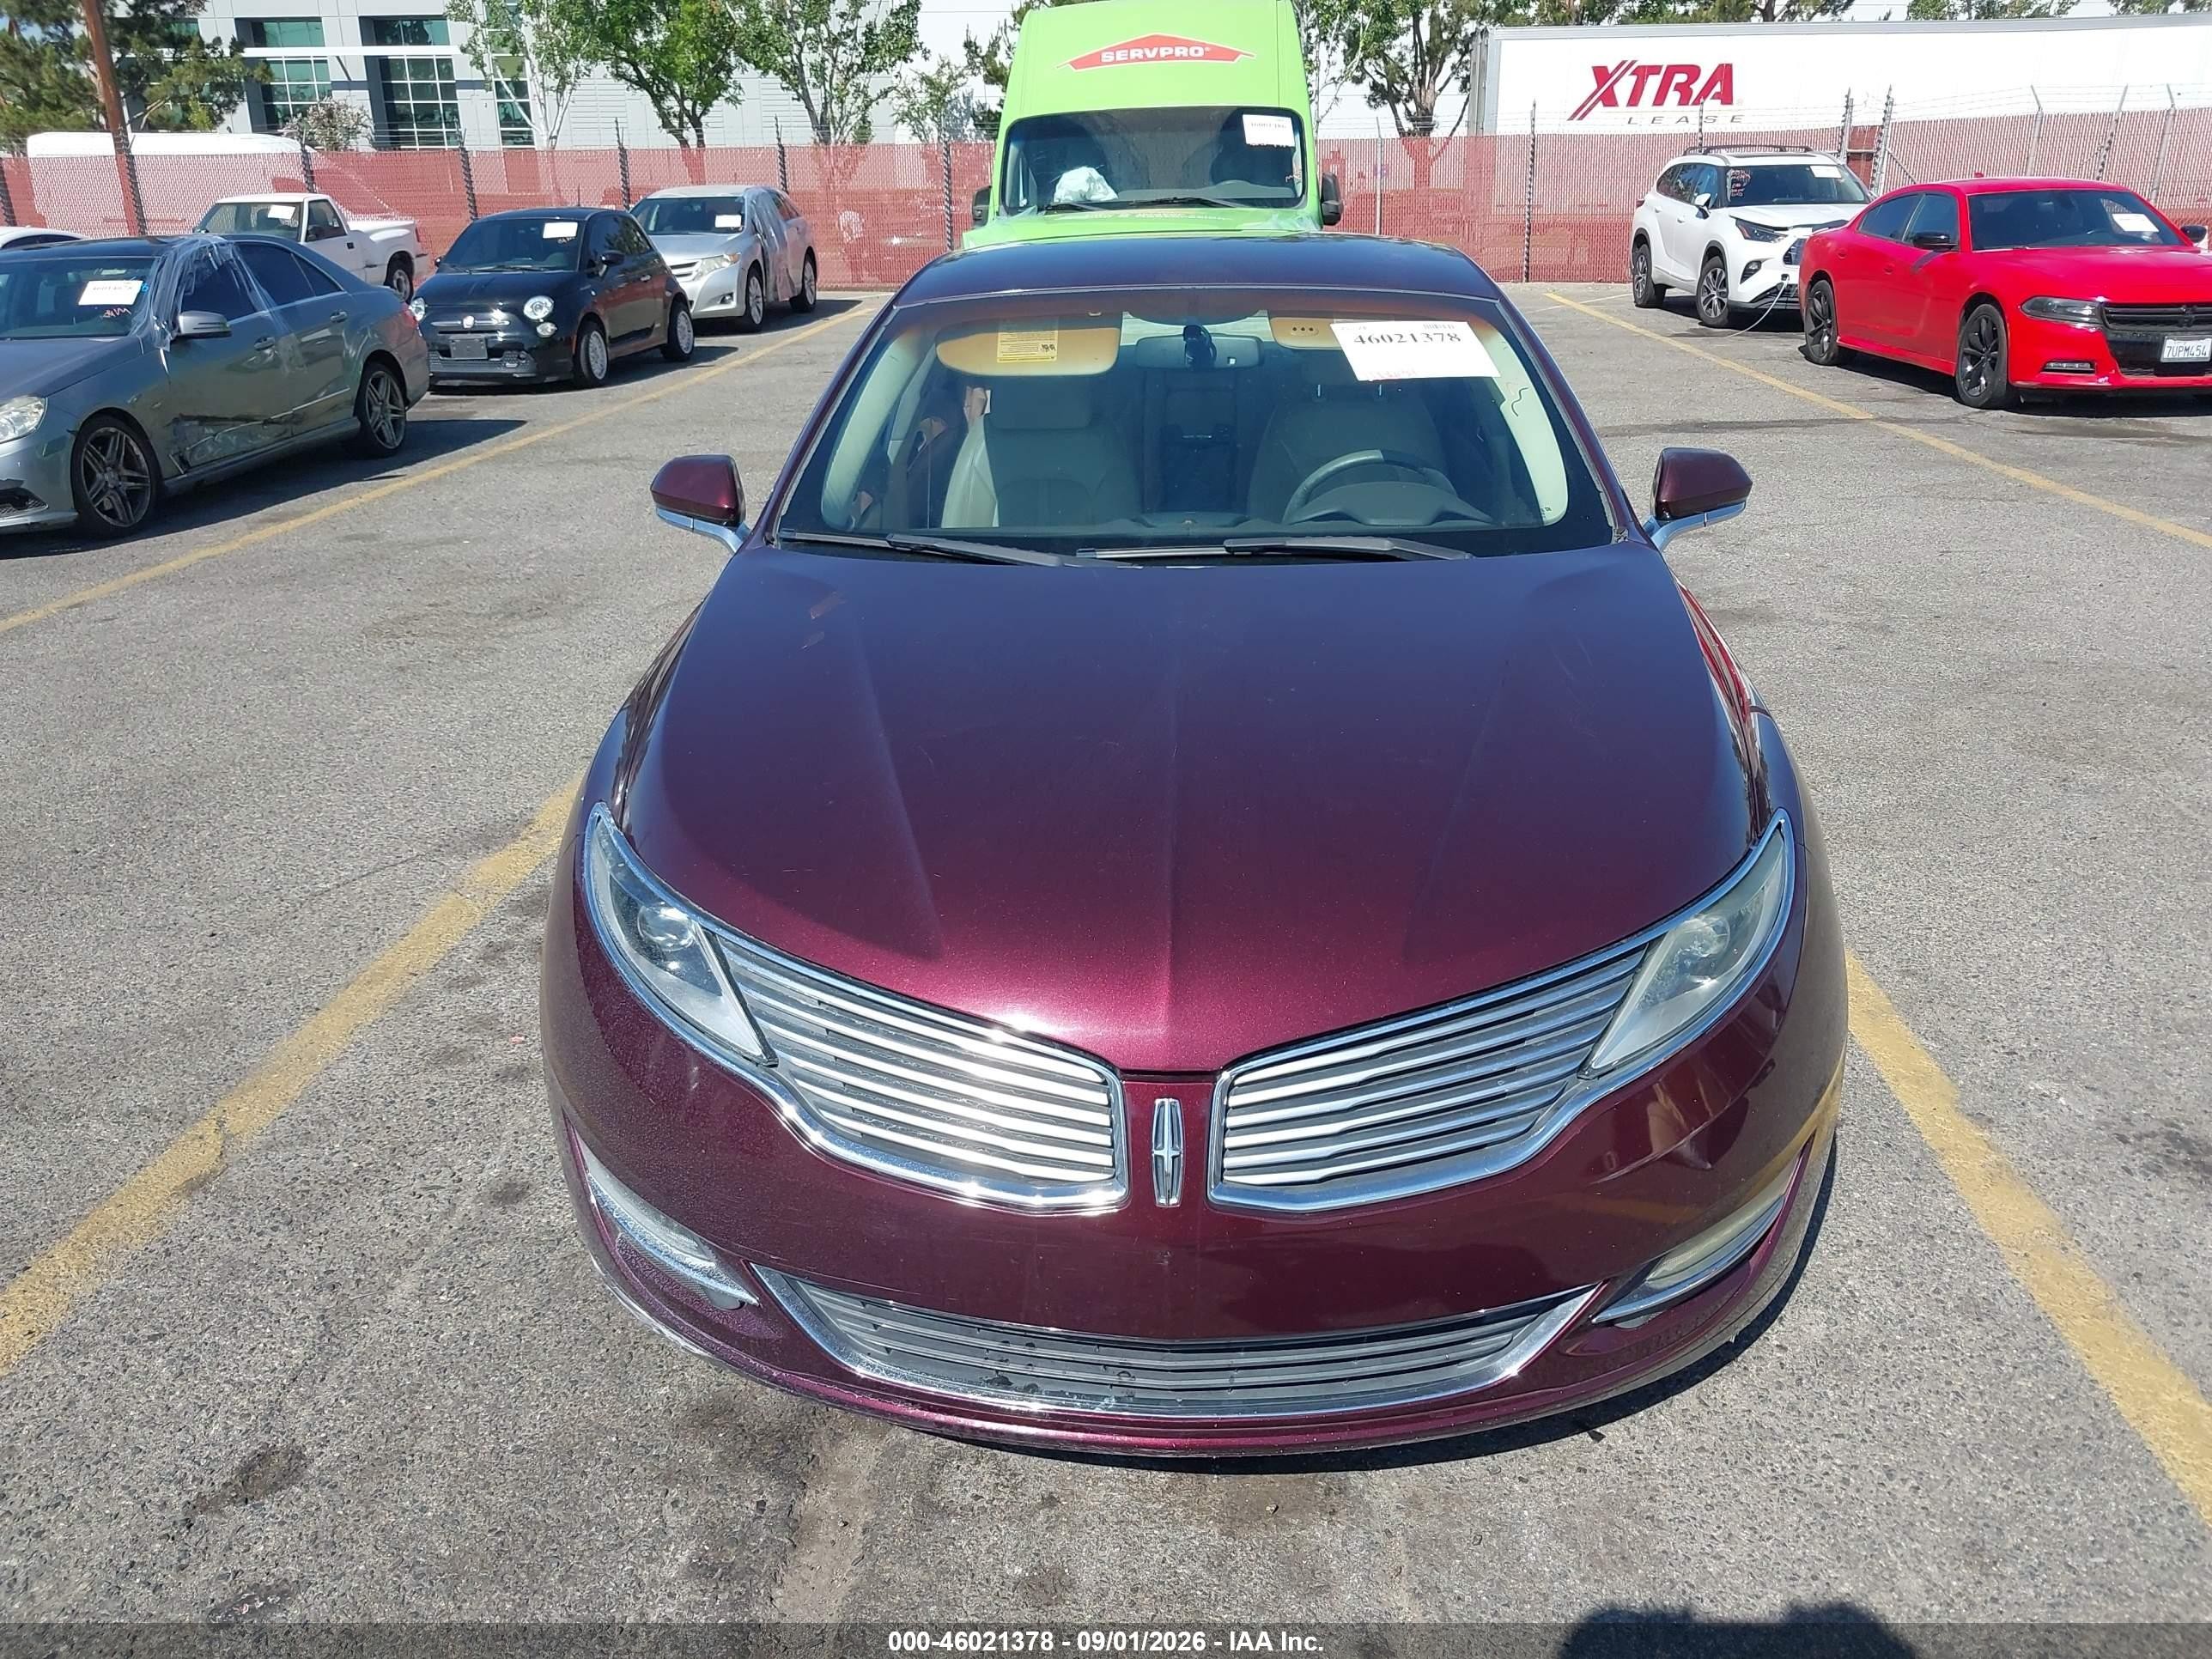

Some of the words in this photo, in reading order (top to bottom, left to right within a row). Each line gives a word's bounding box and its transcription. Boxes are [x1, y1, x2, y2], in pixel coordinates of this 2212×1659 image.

[1567, 60, 1734, 121] XTRA
[1627, 115, 1744, 125] LEASE
[1354, 332, 1462, 344] 46021378
[2166, 345, 2207, 357] 7UPM454
